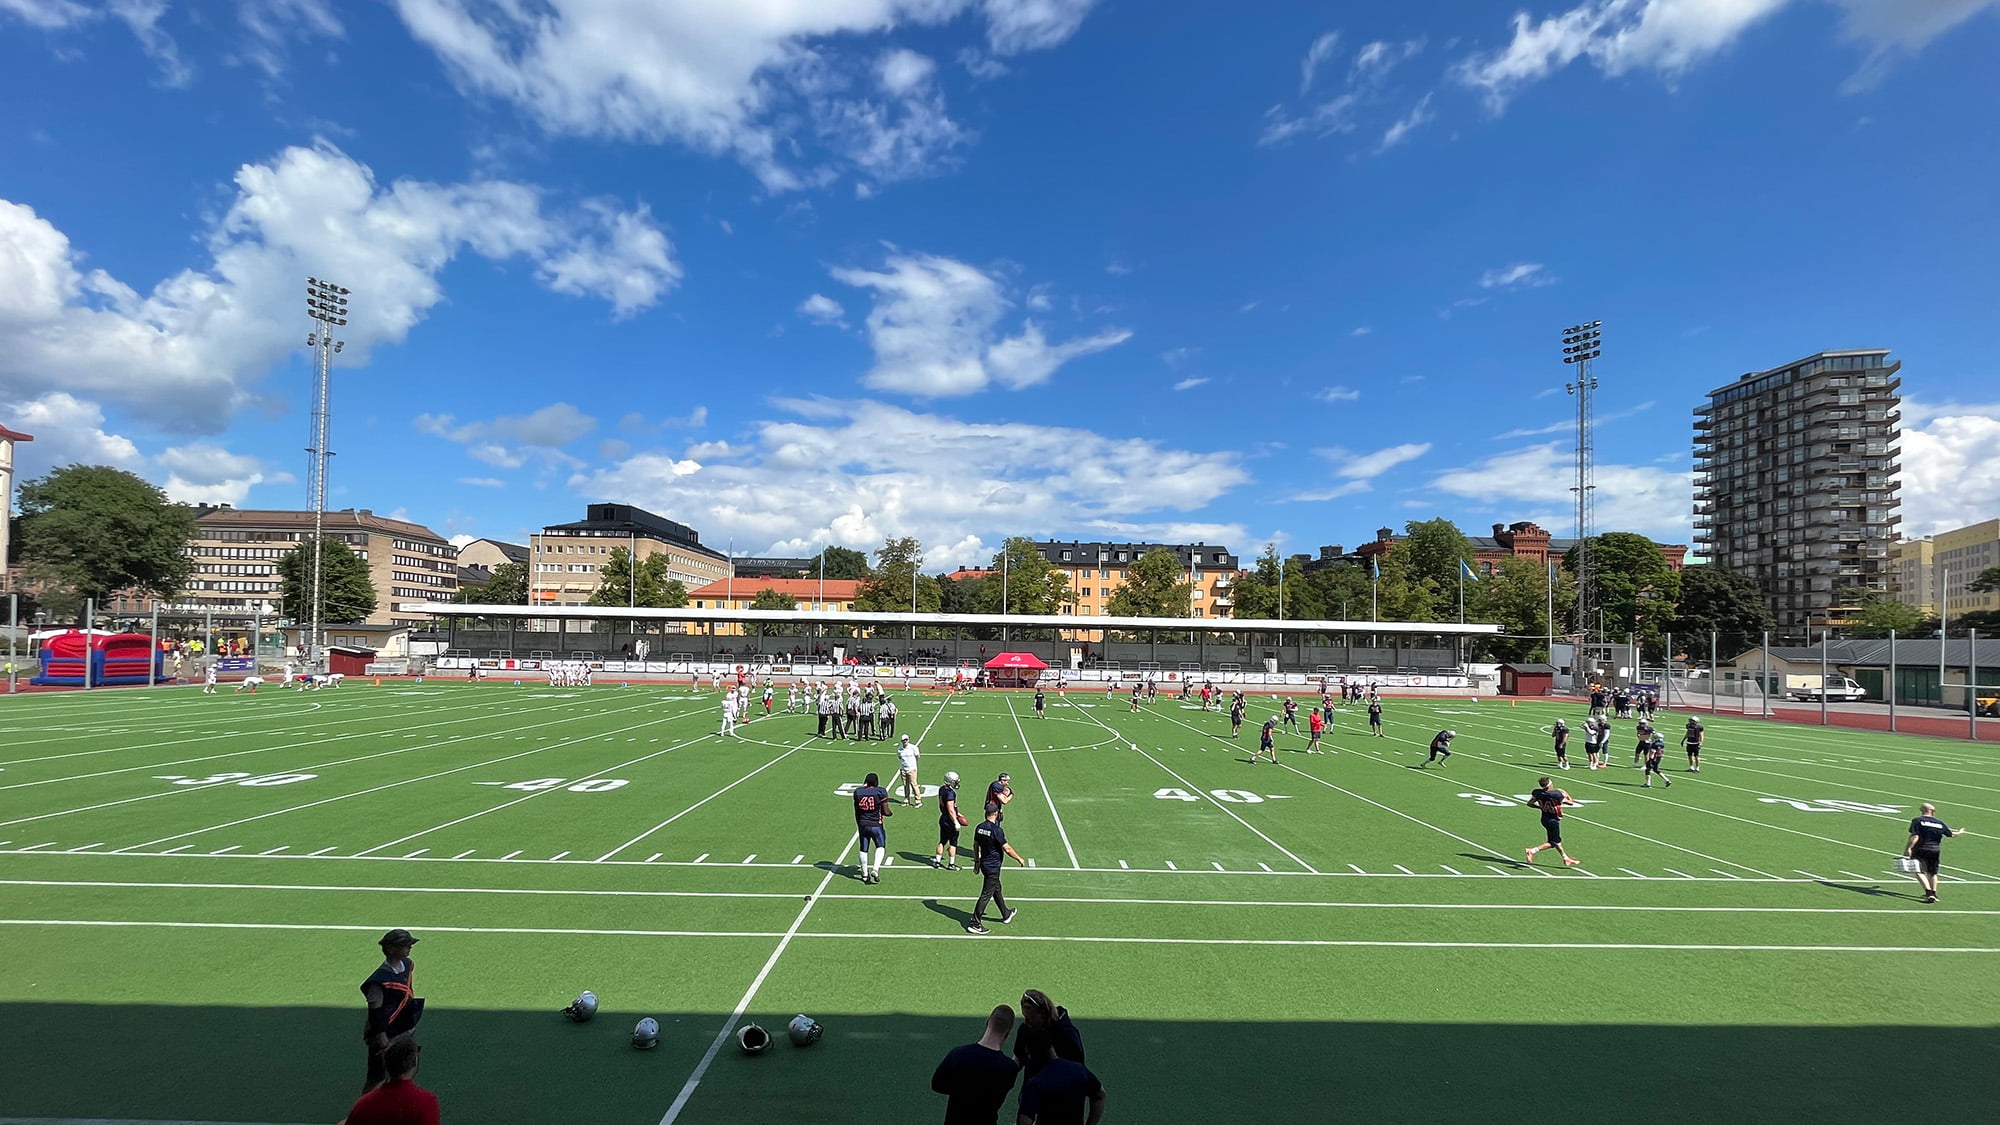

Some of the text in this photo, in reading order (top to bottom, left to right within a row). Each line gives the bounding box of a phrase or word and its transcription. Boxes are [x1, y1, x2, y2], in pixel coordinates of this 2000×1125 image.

[171, 772, 319, 787] 30
[502, 777, 631, 792] 40
[1152, 788, 1265, 804] 40
